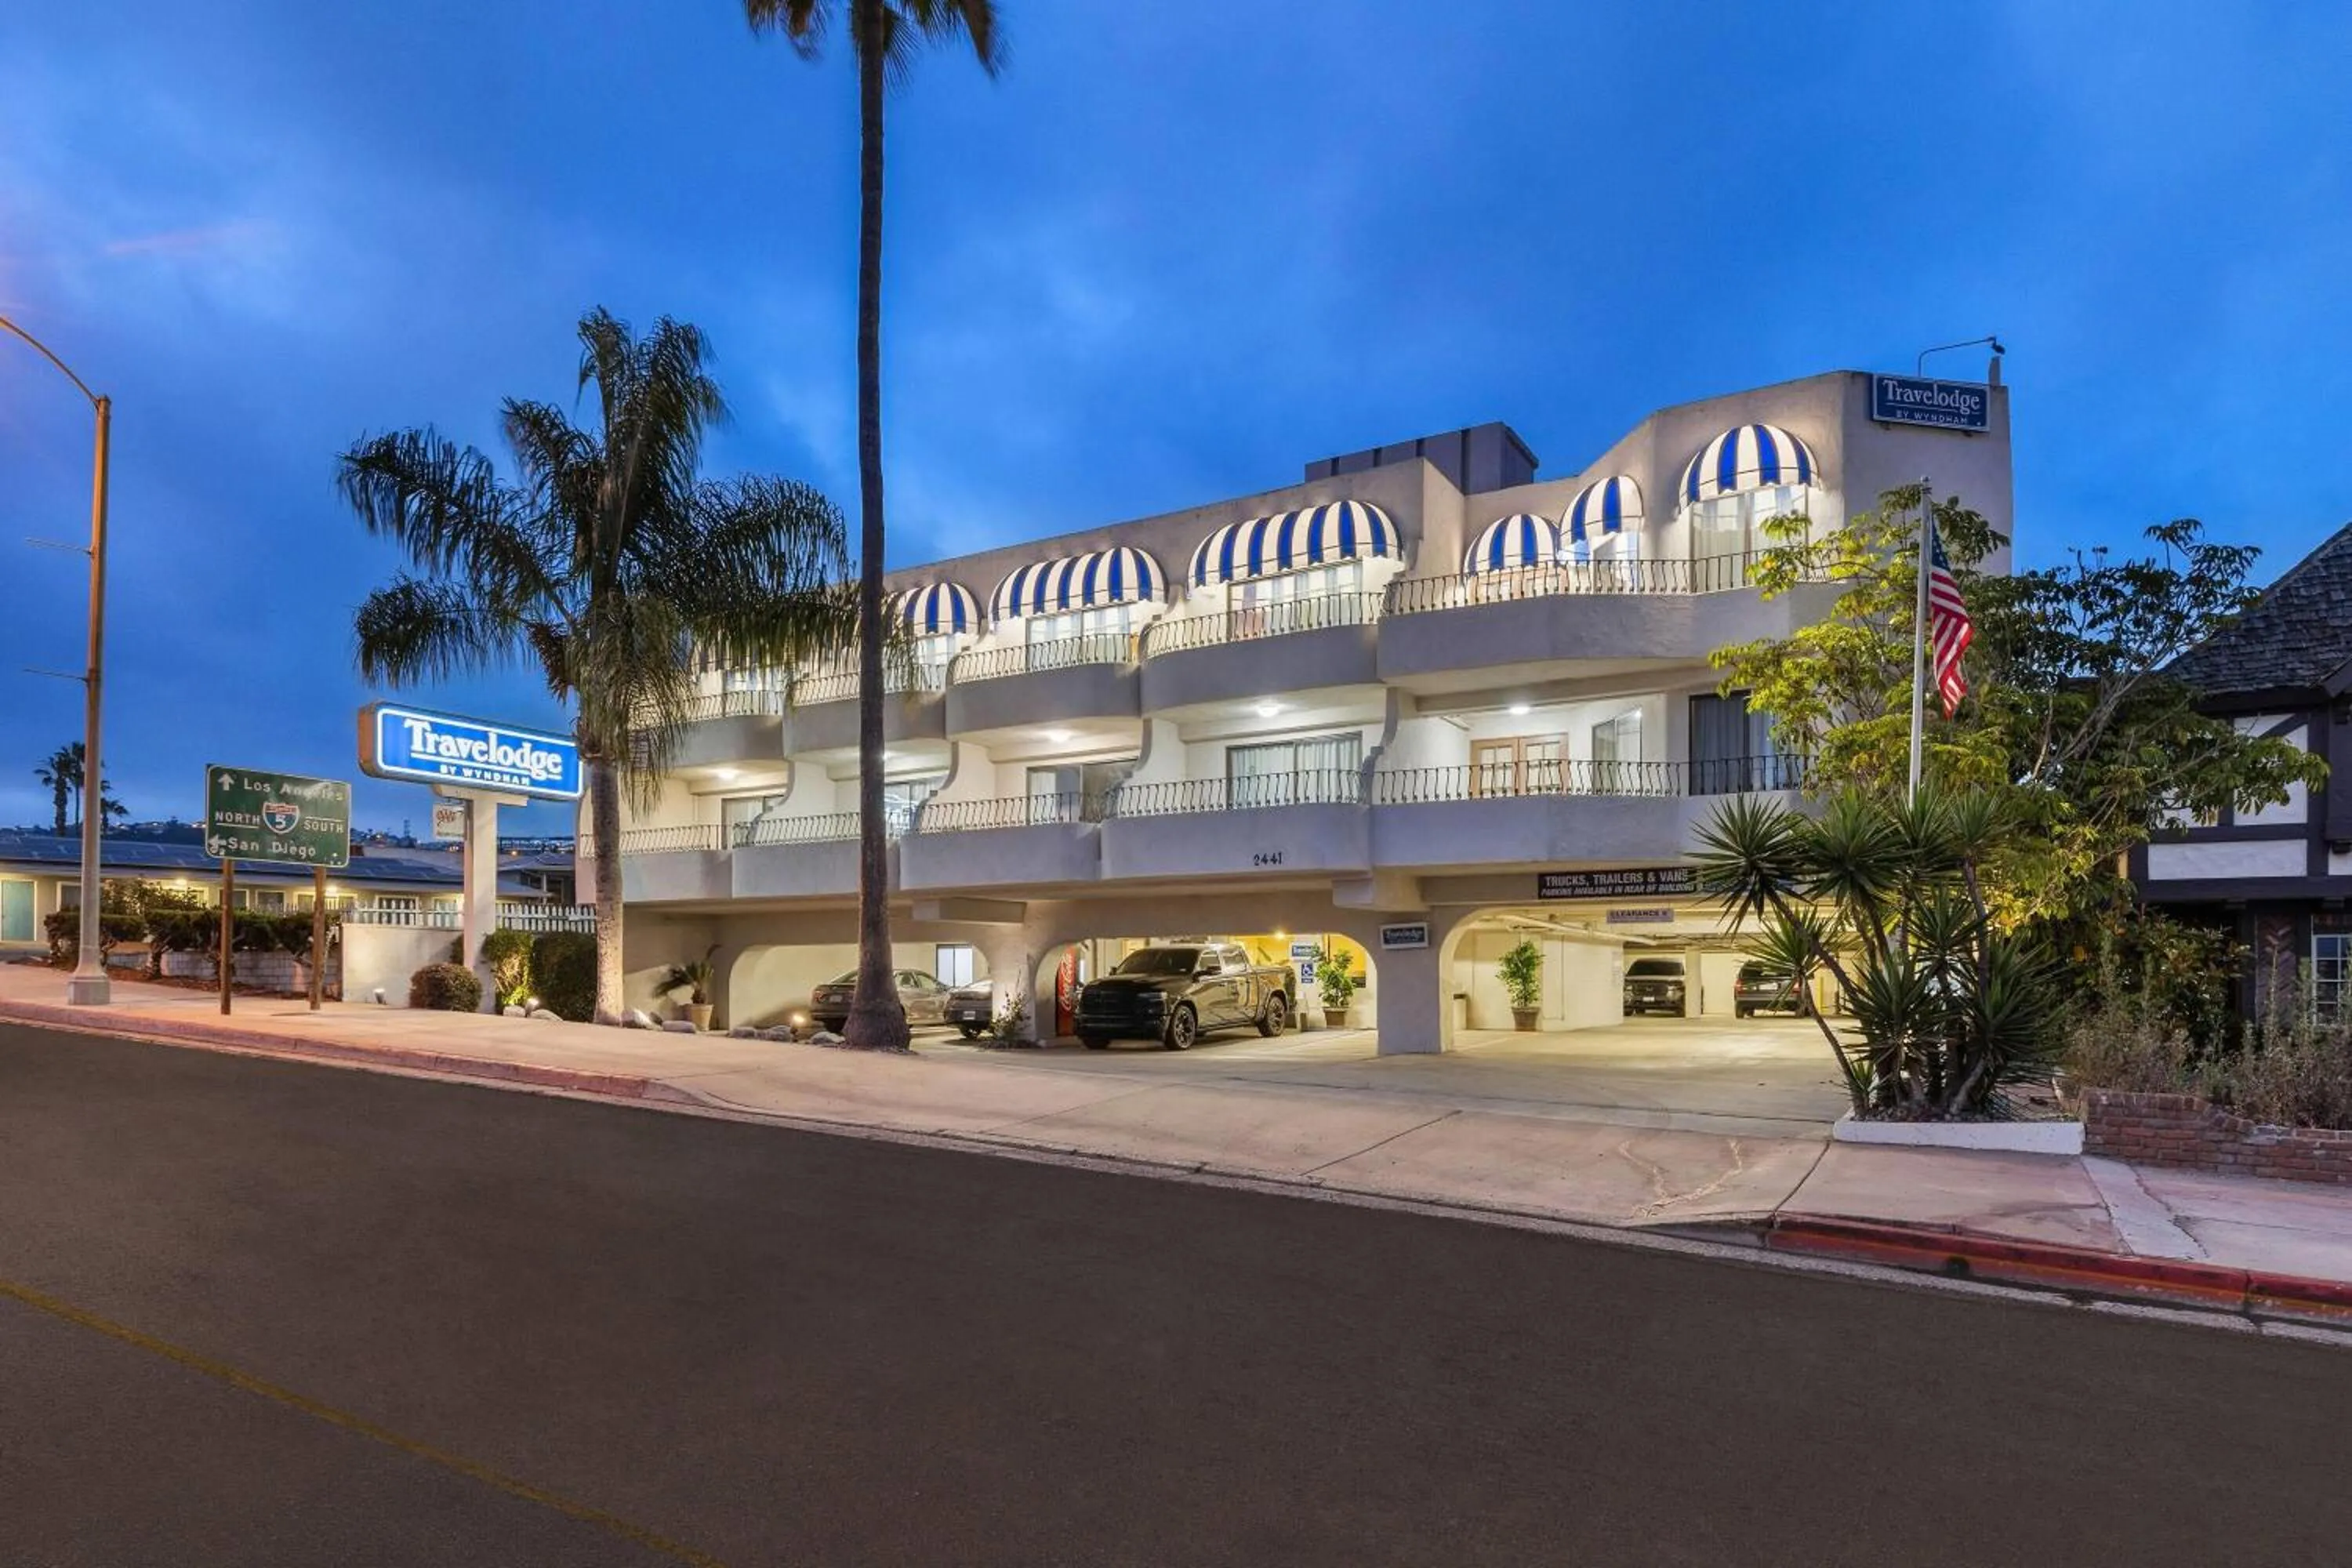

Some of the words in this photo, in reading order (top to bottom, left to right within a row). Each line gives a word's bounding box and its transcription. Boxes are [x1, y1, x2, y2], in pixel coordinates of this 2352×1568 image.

[1882, 379, 1980, 415] Travelodge
[1896, 409, 1909, 419] BY
[1914, 412, 1968, 425] WYNDHAM
[404, 718, 563, 781] Travelodge
[440, 764, 457, 775] BY
[463, 768, 530, 786] WYNDHAM
[244, 778, 271, 793] Los
[215, 810, 261, 825] NORTH
[275, 814, 286, 829] 5
[303, 819, 344, 833] SOUTH
[228, 837, 260, 851] San
[271, 841, 316, 859] Diego
[1254, 851, 1282, 866] 2441
[1593, 871, 1644, 885] TRAILERS
